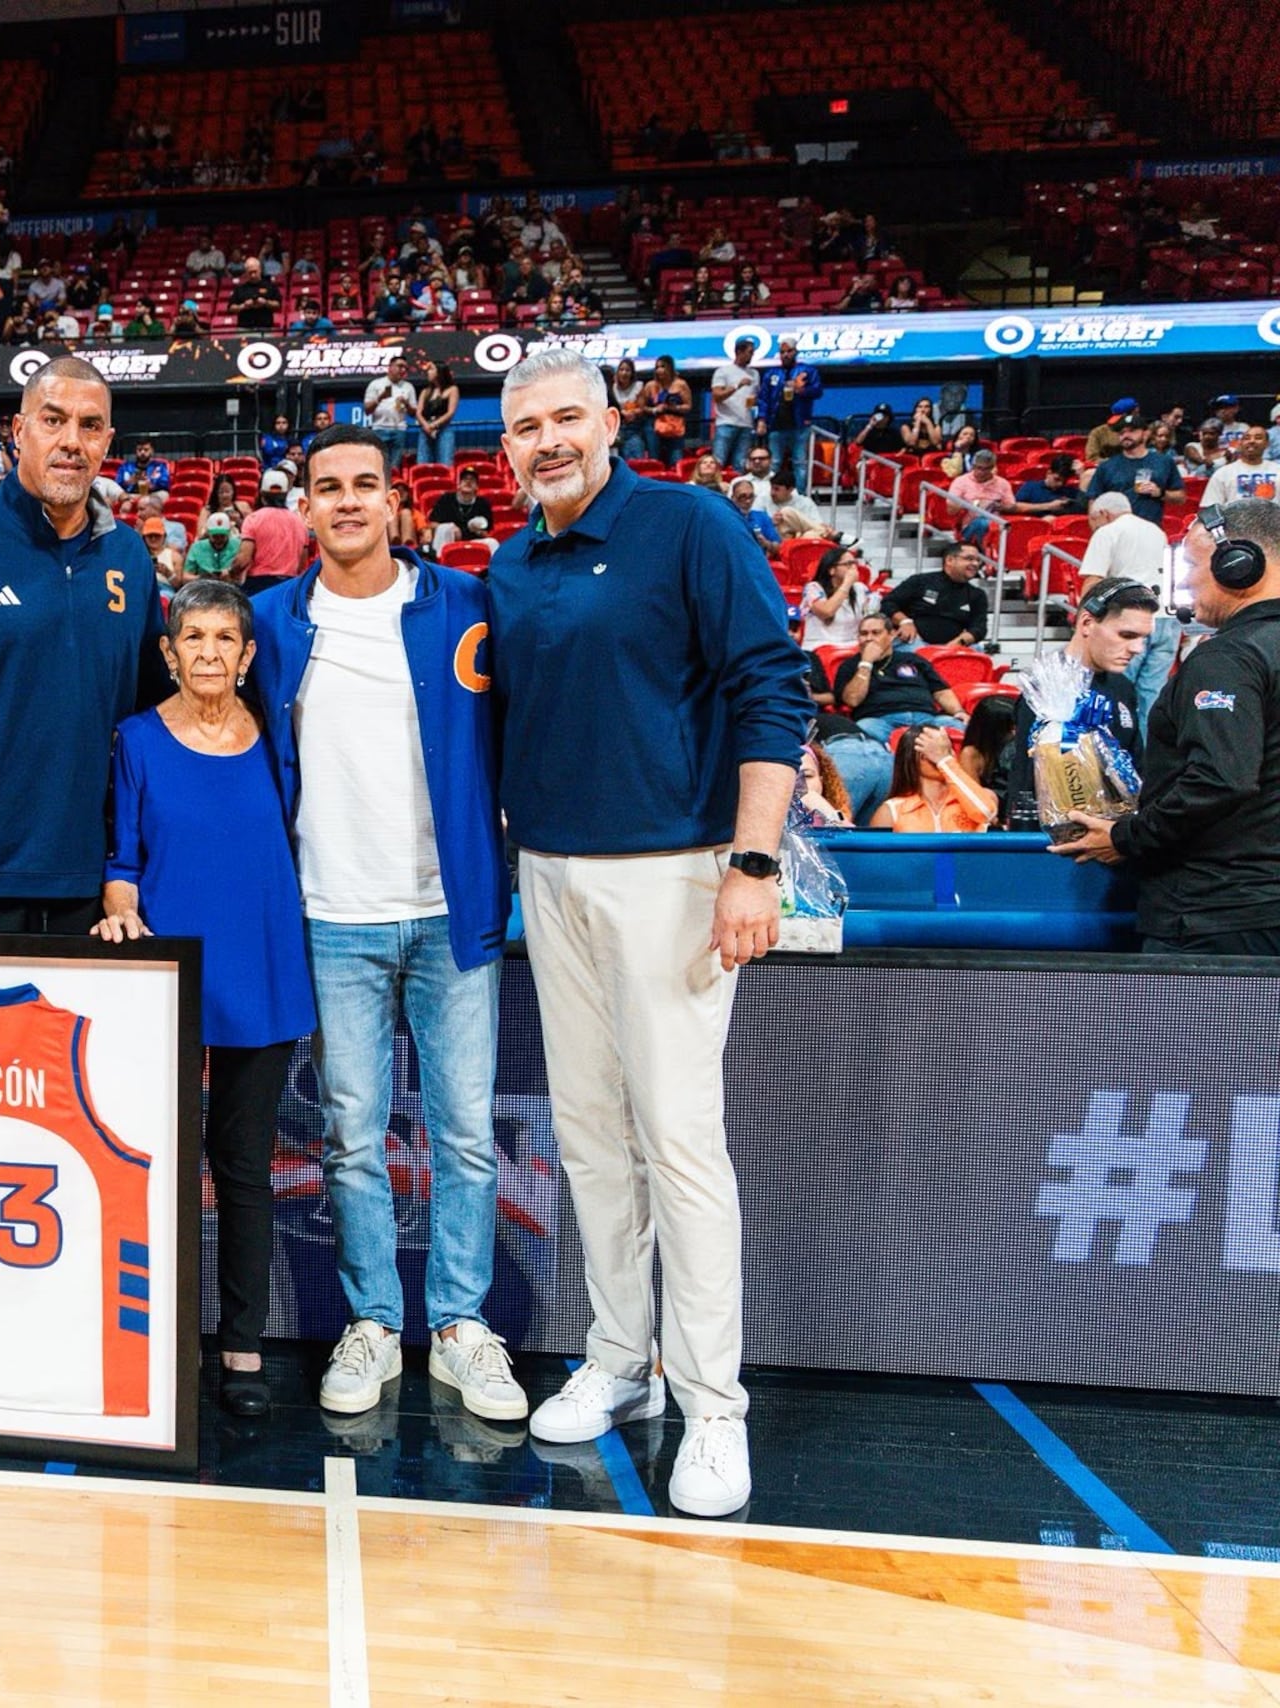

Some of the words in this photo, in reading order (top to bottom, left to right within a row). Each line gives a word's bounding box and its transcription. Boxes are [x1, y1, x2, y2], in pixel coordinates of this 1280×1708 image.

[275, 10, 322, 46] SUR
[1039, 321, 1175, 343] TARGET
[84, 354, 169, 375] RGET
[286, 346, 403, 368] TARGET
[363, 366, 389, 374] TRUC
[105, 569, 126, 613] S
[453, 621, 492, 693] C
